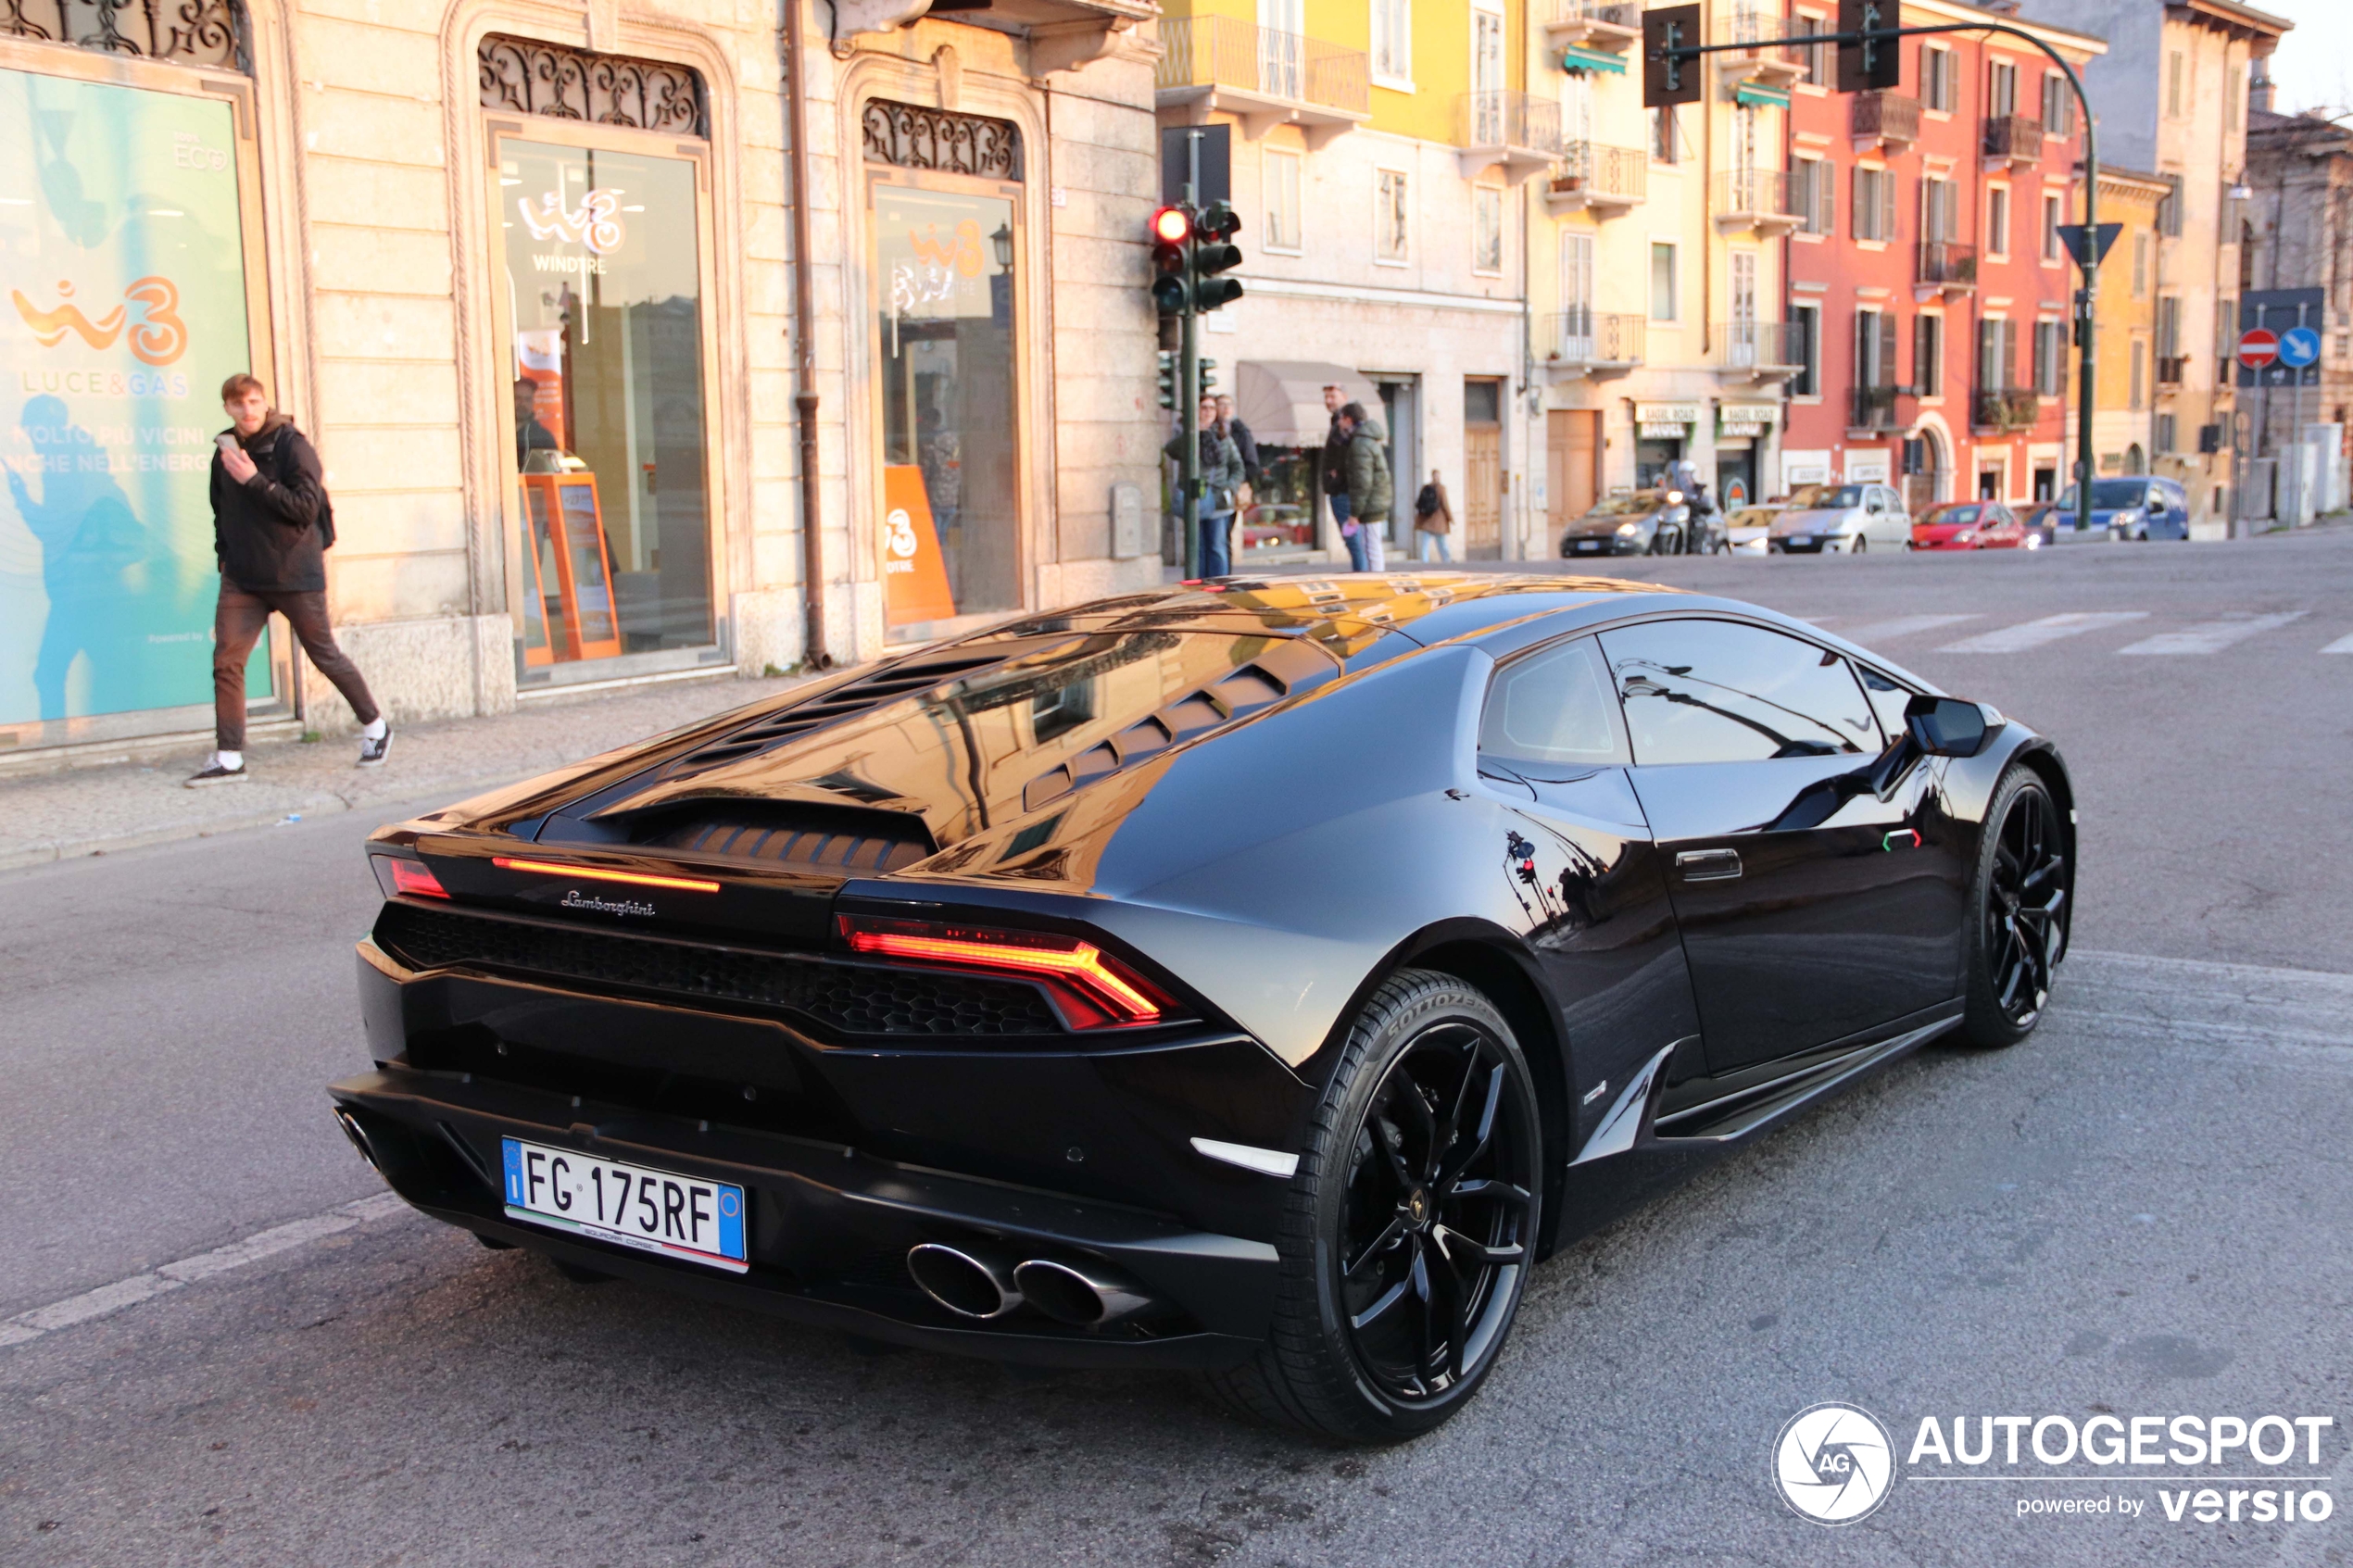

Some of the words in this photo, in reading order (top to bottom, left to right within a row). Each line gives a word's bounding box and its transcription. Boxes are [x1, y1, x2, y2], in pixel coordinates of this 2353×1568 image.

[533, 255, 608, 275] WINDTRE
[142, 427, 205, 445] VICINI
[560, 890, 655, 916] Lamborghini
[526, 1150, 573, 1211] FG
[591, 1166, 711, 1243] 175RF
[585, 1228, 623, 1243] SQUADRA
[626, 1238, 654, 1250] CORSE
